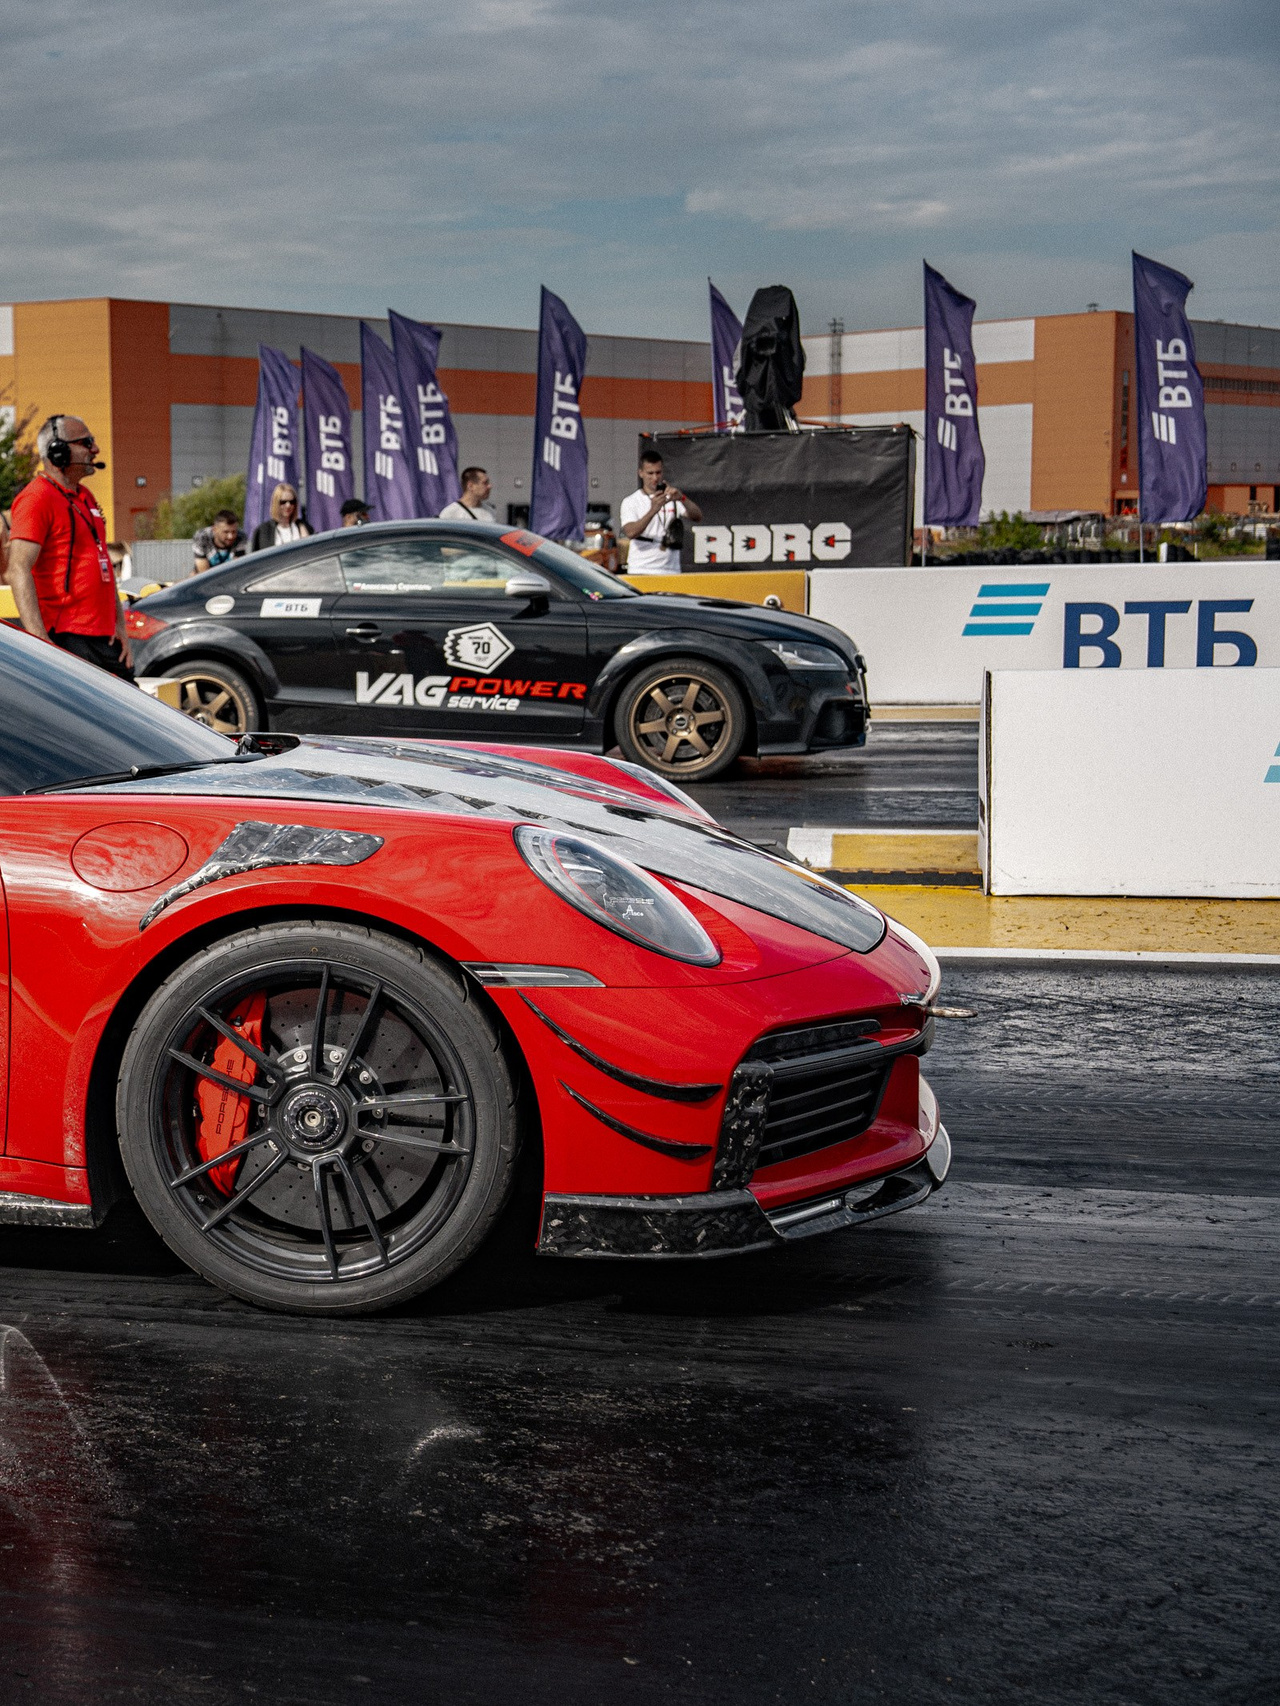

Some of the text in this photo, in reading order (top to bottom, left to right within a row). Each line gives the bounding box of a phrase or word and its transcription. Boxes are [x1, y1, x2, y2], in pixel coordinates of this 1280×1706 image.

[943, 347, 974, 417] ВТБ
[1156, 338, 1193, 408] ВТБ
[271, 406, 292, 457] ВТБ
[379, 394, 403, 450] ВТБ
[417, 381, 445, 444] ВТБ
[550, 371, 580, 440] ВТБ
[319, 415, 346, 471] ВТБ
[691, 521, 852, 563] RDRC
[284, 603, 308, 613] ВТБ
[1063, 599, 1258, 668] ВТБ
[472, 642, 490, 654] 70
[356, 671, 588, 707] VAG POWER
[447, 694, 520, 712] service
